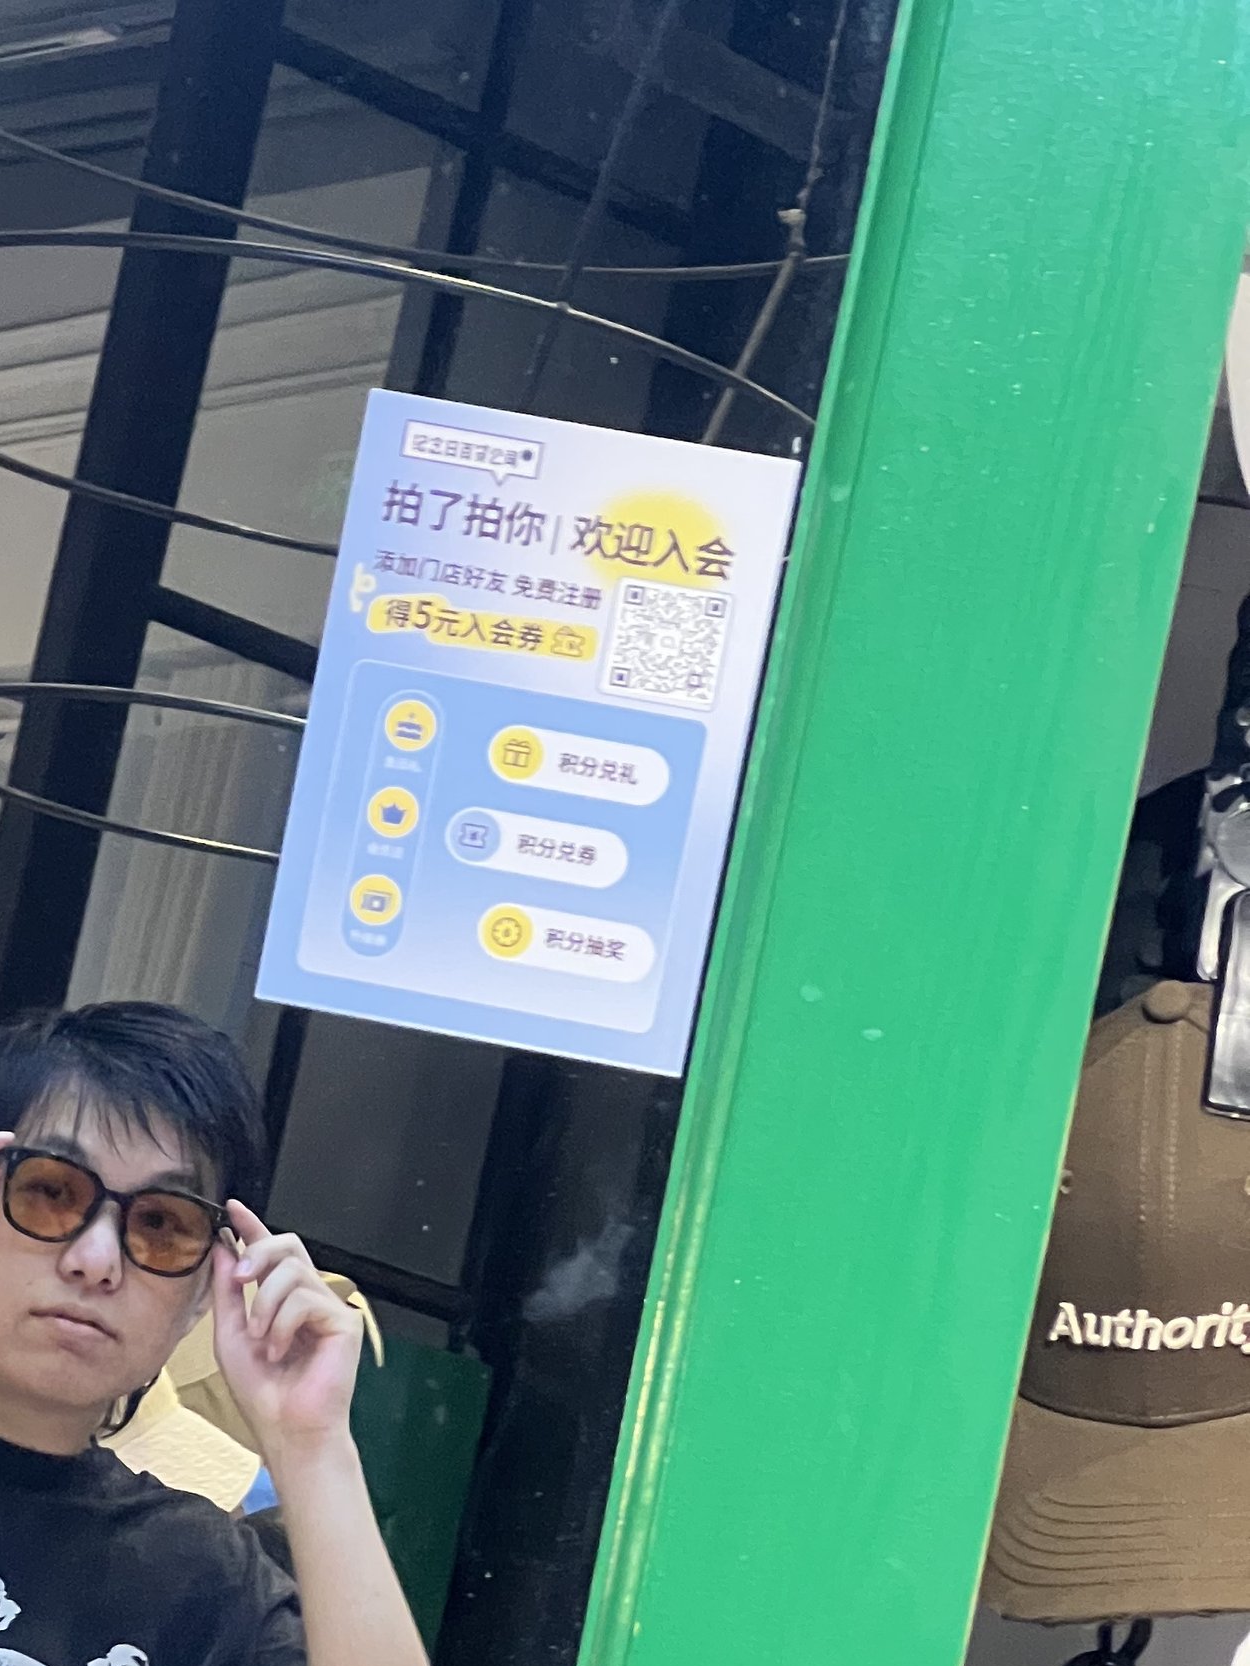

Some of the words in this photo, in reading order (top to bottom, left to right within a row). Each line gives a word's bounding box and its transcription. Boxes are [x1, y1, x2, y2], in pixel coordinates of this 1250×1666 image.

[381, 481, 547, 547] 拍了拍你
[570, 515, 736, 580] 欢迎入会
[373, 549, 508, 595] 添加门店好友
[513, 574, 602, 610] 免费注册
[385, 597, 543, 652] 得5元入会券
[558, 752, 639, 786] 积分兑礼
[544, 927, 628, 961] 积分抽奖
